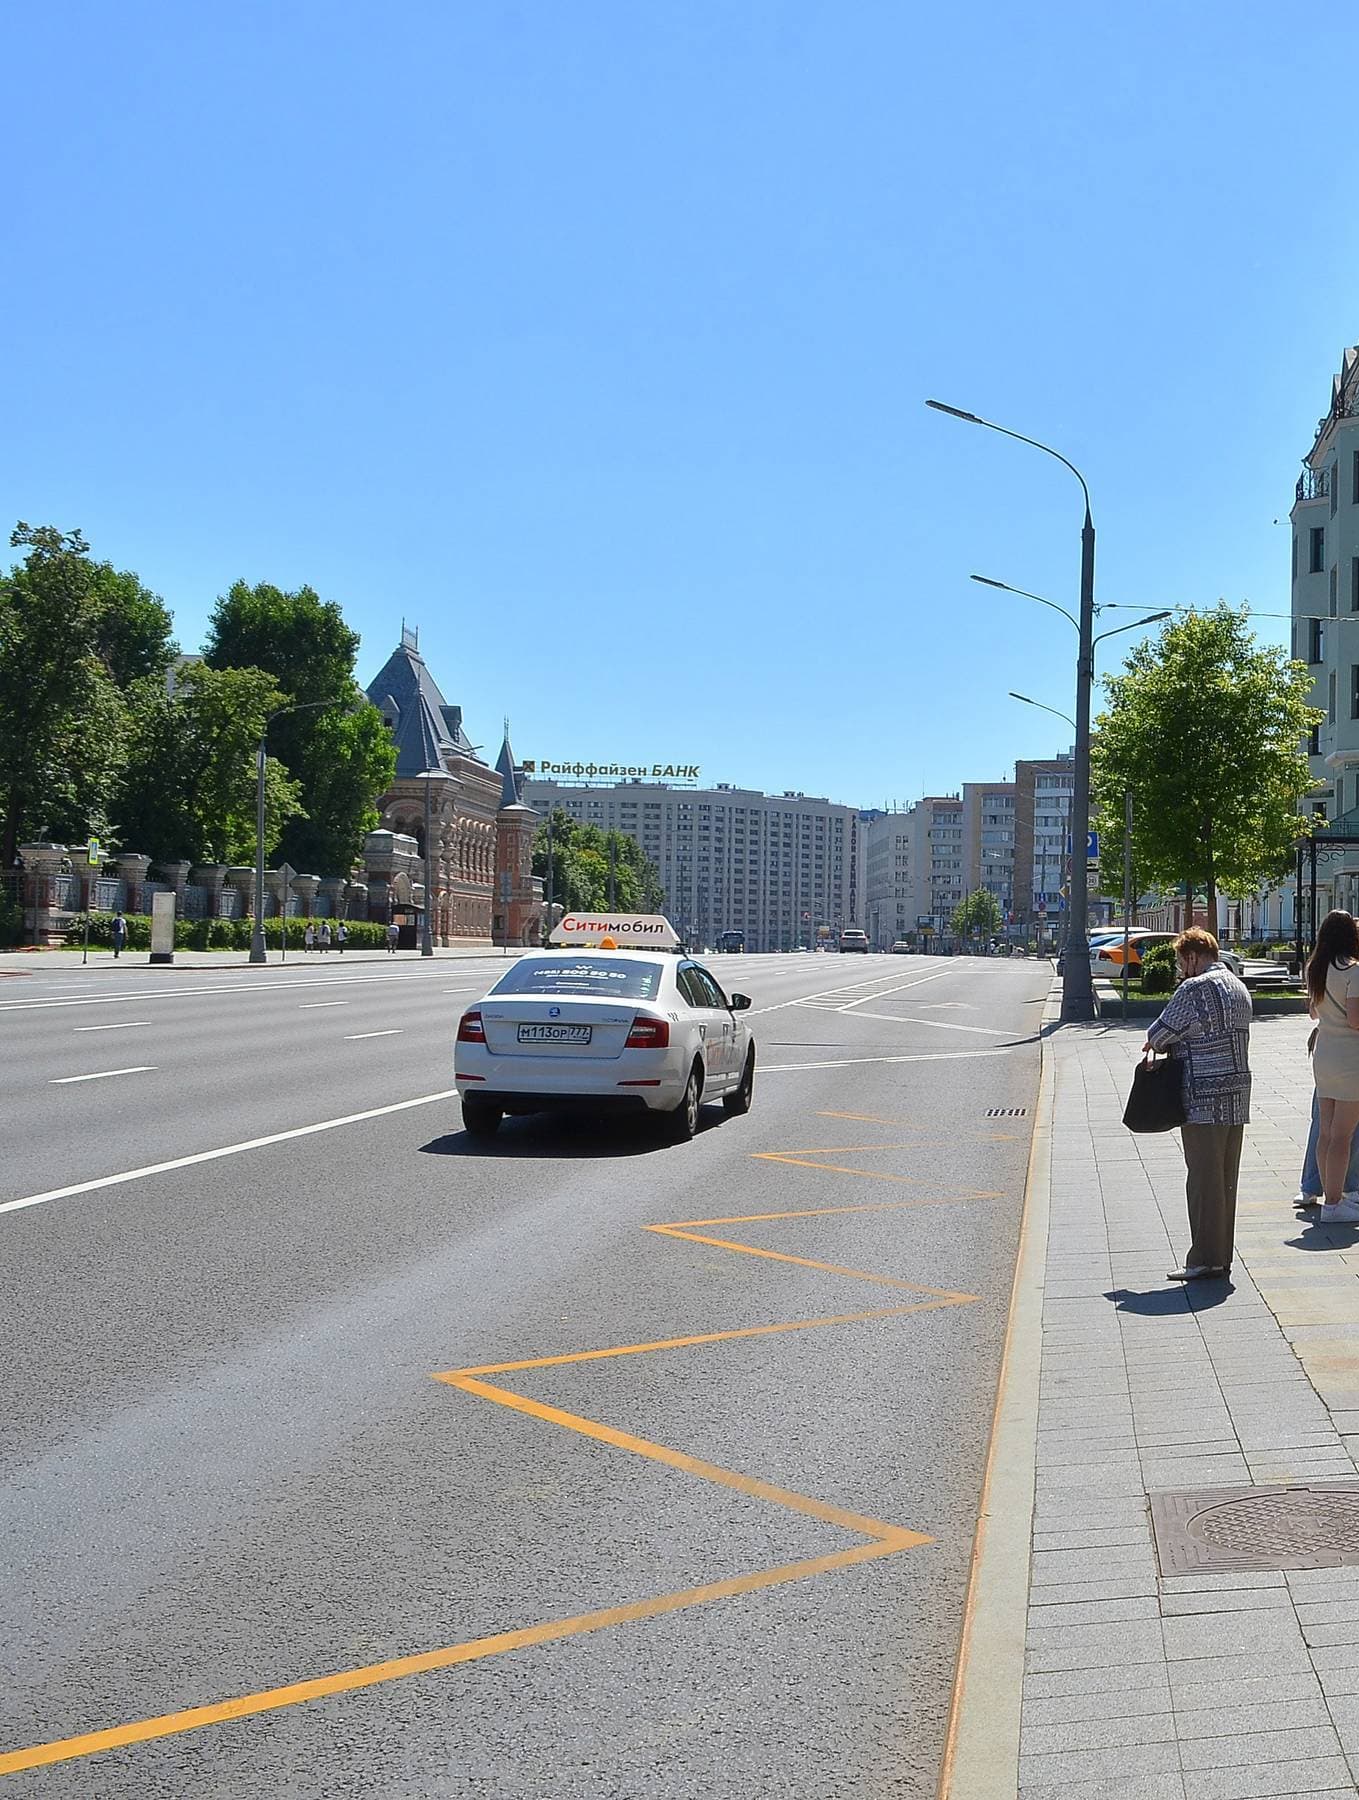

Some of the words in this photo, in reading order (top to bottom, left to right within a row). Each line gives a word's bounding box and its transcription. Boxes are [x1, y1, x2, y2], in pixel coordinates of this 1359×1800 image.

[541, 760, 647, 777] Райффайзен
[651, 764, 701, 778] БАНК
[562, 918, 664, 933] Ситимобил
